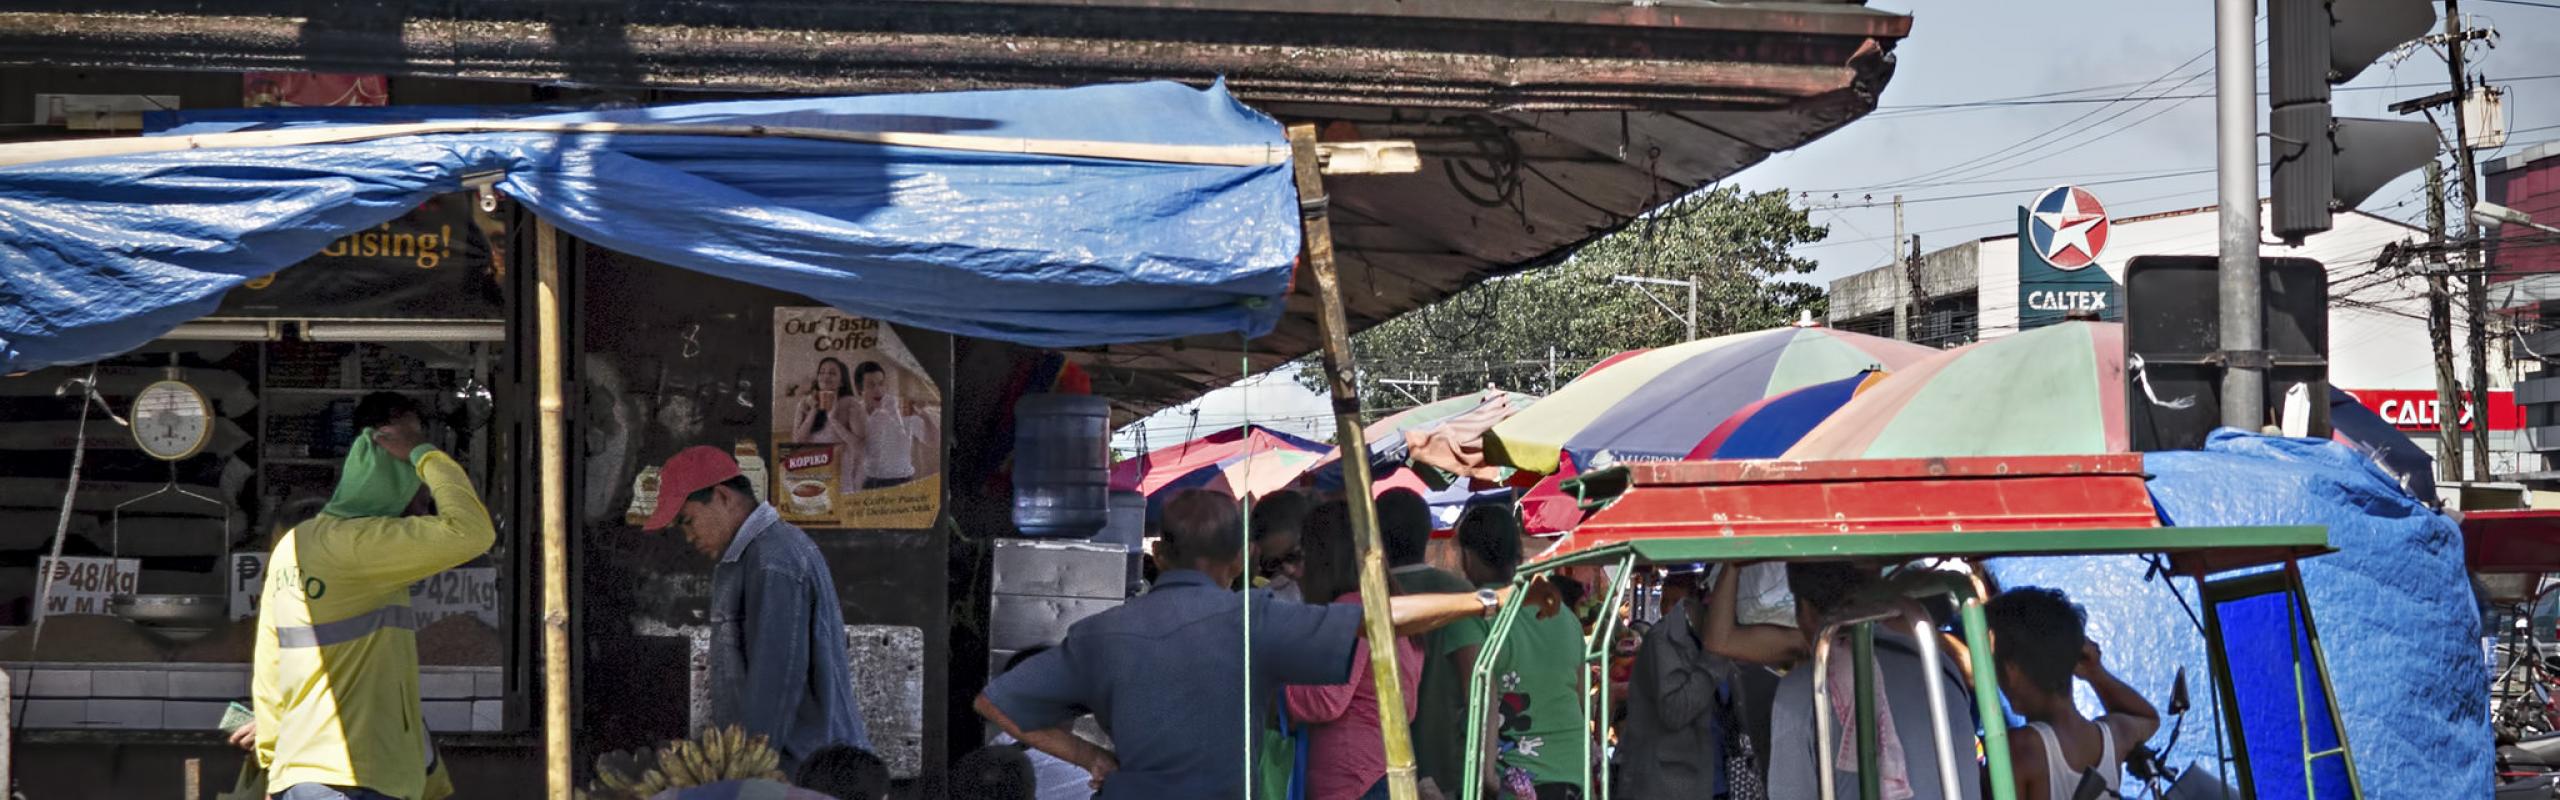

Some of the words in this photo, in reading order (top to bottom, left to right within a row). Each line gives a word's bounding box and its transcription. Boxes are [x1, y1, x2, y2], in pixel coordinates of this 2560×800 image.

[2028, 291, 2106, 311] CALTEX
[785, 318, 821, 336] Our
[2380, 400, 2474, 425] CALTX
[789, 453, 829, 470] KOPIKO
